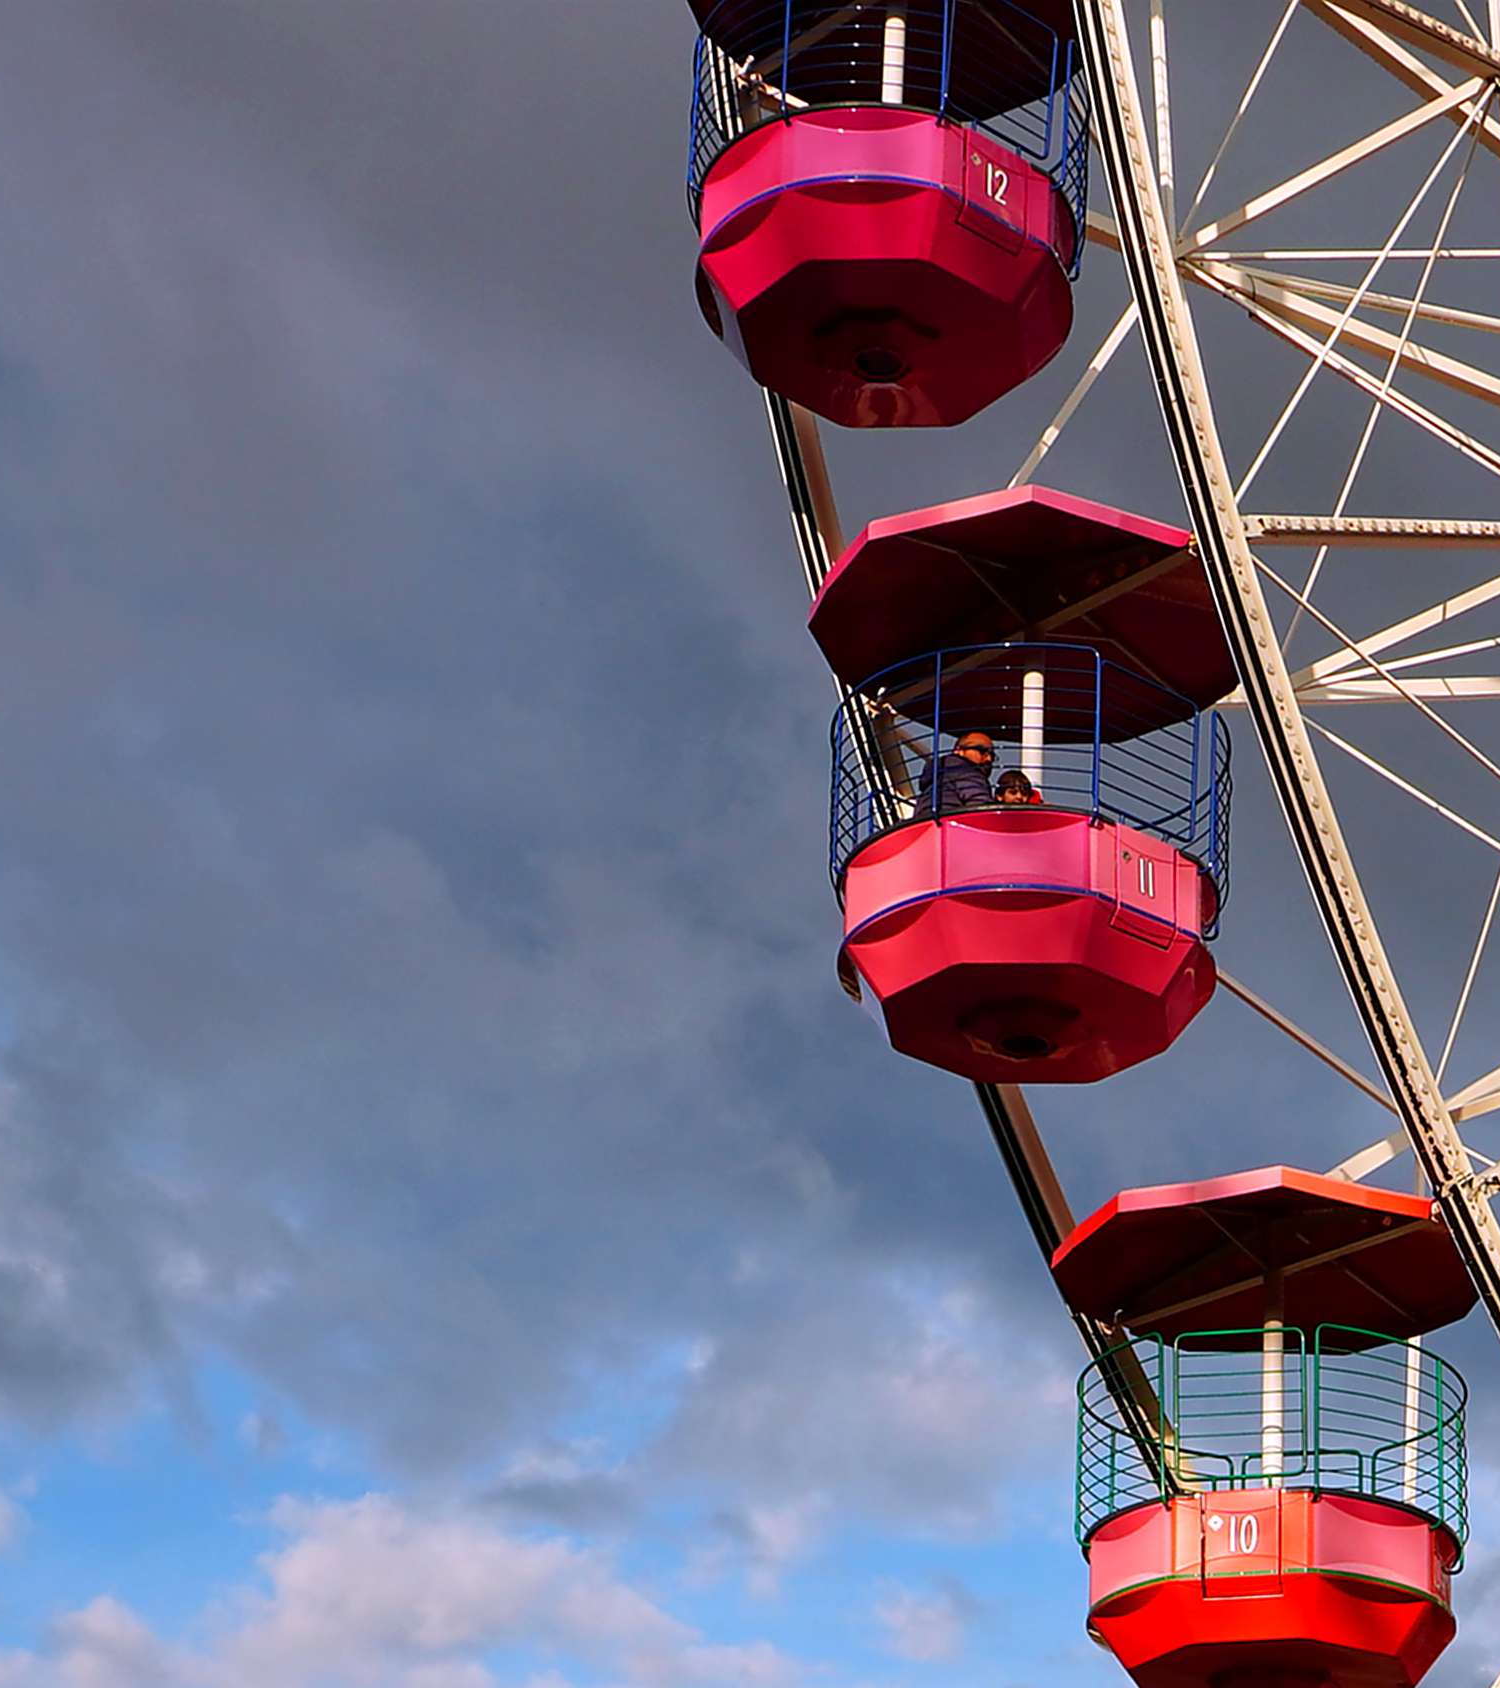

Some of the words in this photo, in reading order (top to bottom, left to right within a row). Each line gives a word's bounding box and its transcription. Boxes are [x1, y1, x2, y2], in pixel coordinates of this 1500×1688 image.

[983, 161, 1010, 207] 12
[1137, 857, 1156, 900] 11
[1227, 1514, 1259, 1555] 10
